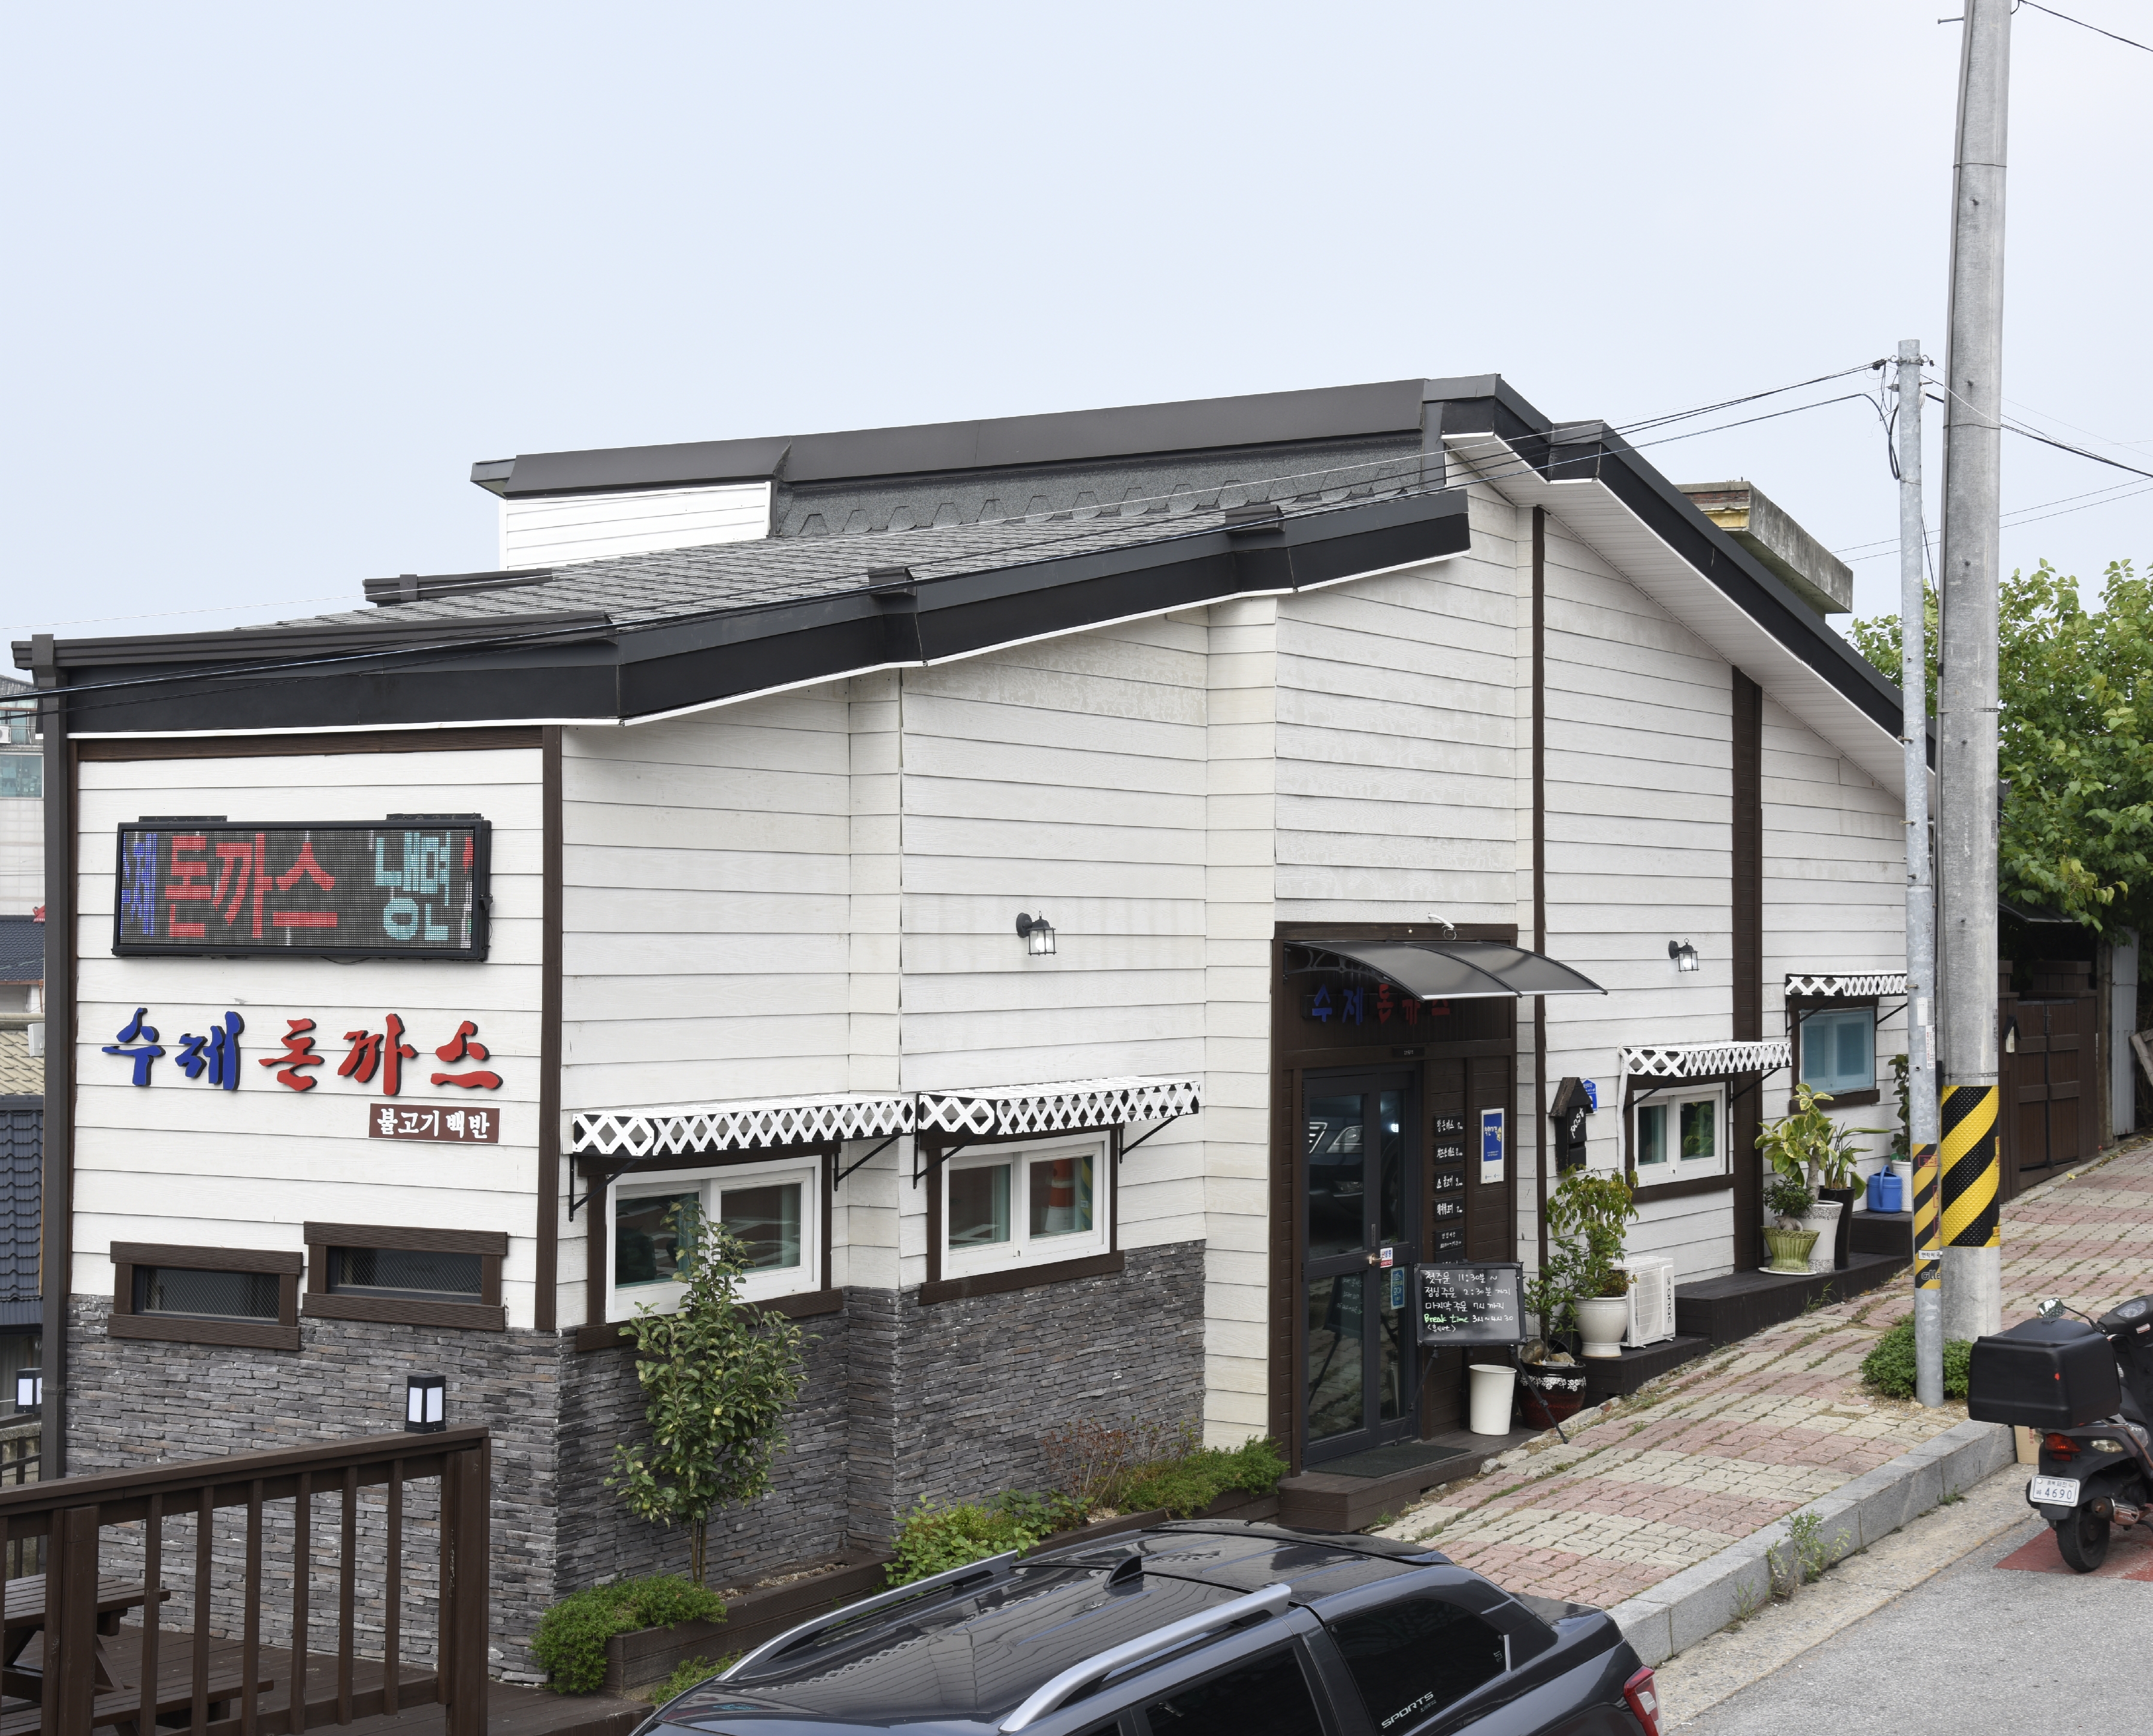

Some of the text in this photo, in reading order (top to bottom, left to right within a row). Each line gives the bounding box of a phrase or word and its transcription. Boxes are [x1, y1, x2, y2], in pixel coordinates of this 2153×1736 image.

[165, 833, 338, 939] 돈까스
[375, 831, 451, 941] 냉면
[1312, 984, 1363, 1026] 수제
[101, 1006, 503, 1096] 수제 돈까스
[1570, 1107, 1584, 1139] post
[1424, 1313, 1447, 1323] Break
[1449, 1314, 1469, 1323] time
[2045, 1487, 2072, 1499] 4690
[1381, 1691, 1434, 1729] SPORTS
